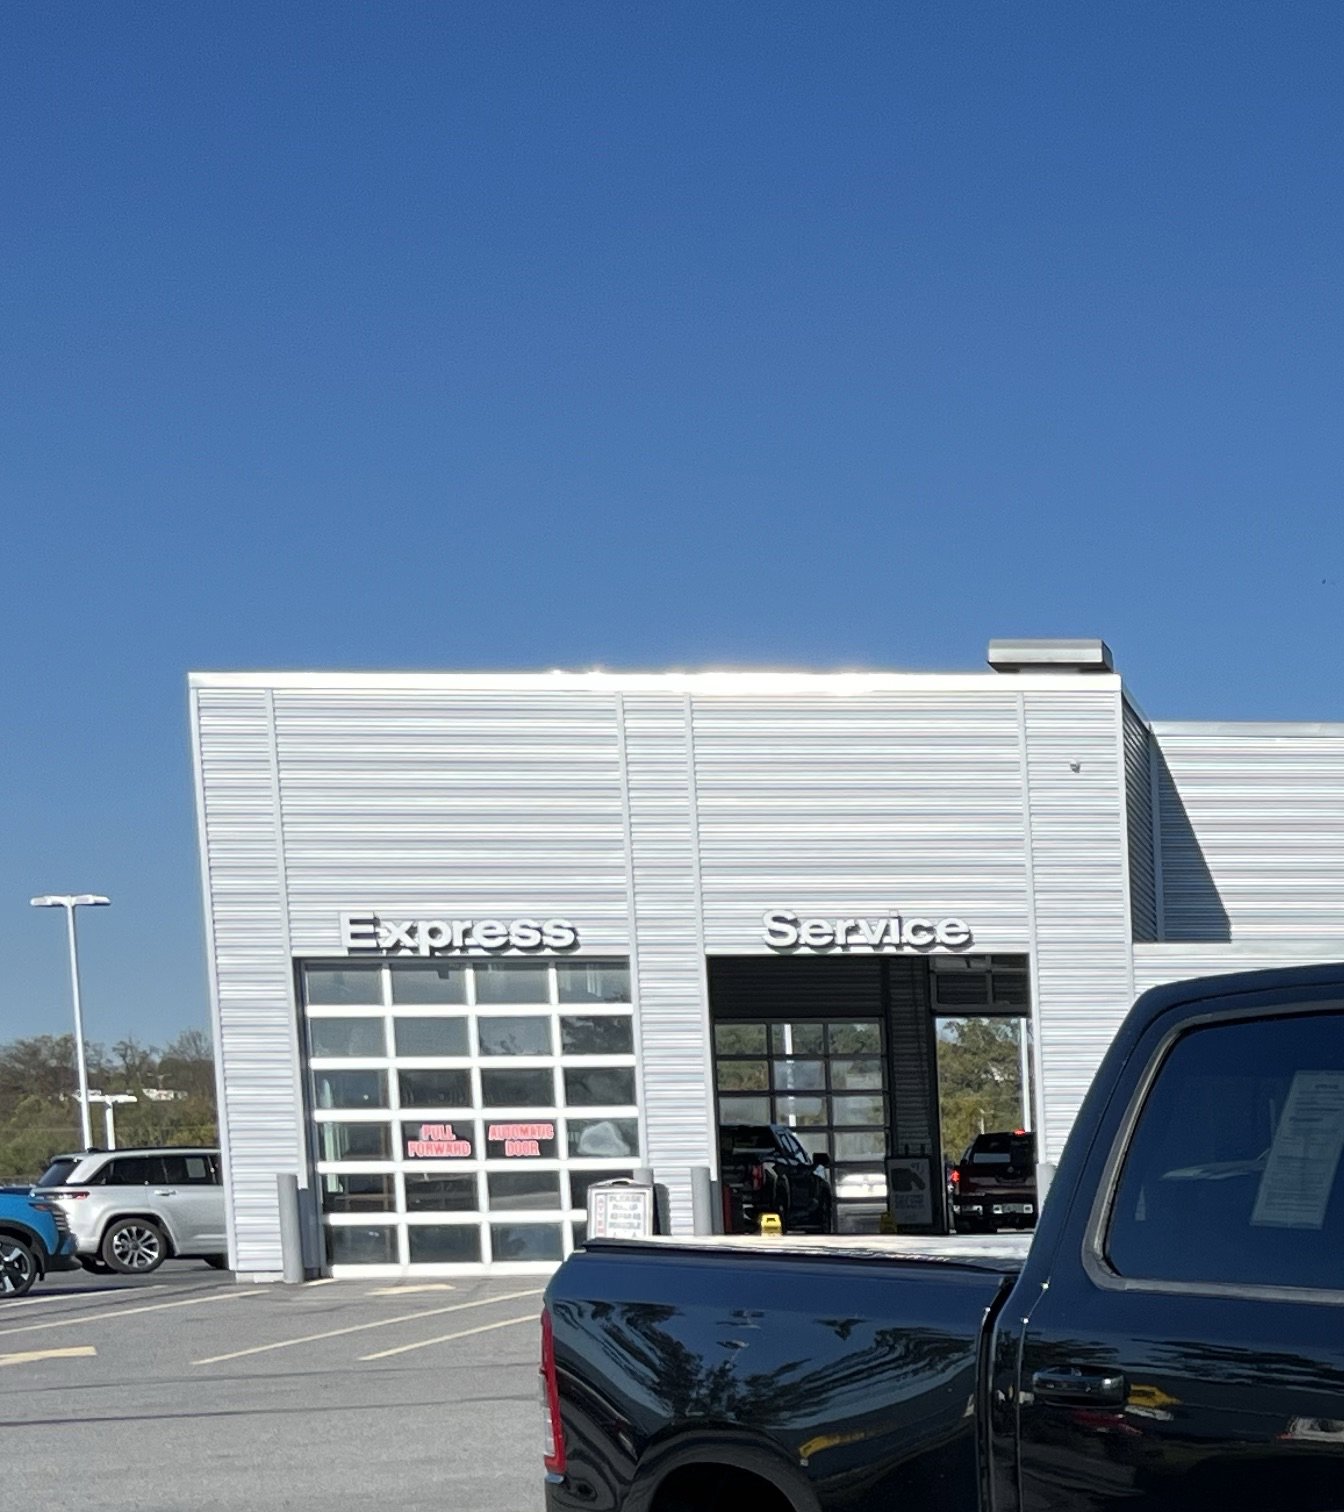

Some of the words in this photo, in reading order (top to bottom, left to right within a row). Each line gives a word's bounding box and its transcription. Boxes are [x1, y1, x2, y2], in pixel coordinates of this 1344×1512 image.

[339, 911, 578, 957] Express
[763, 909, 972, 949] Service
[421, 1123, 457, 1141] PULL
[407, 1140, 472, 1157] FORWARD
[505, 1140, 541, 1156] DOOR
